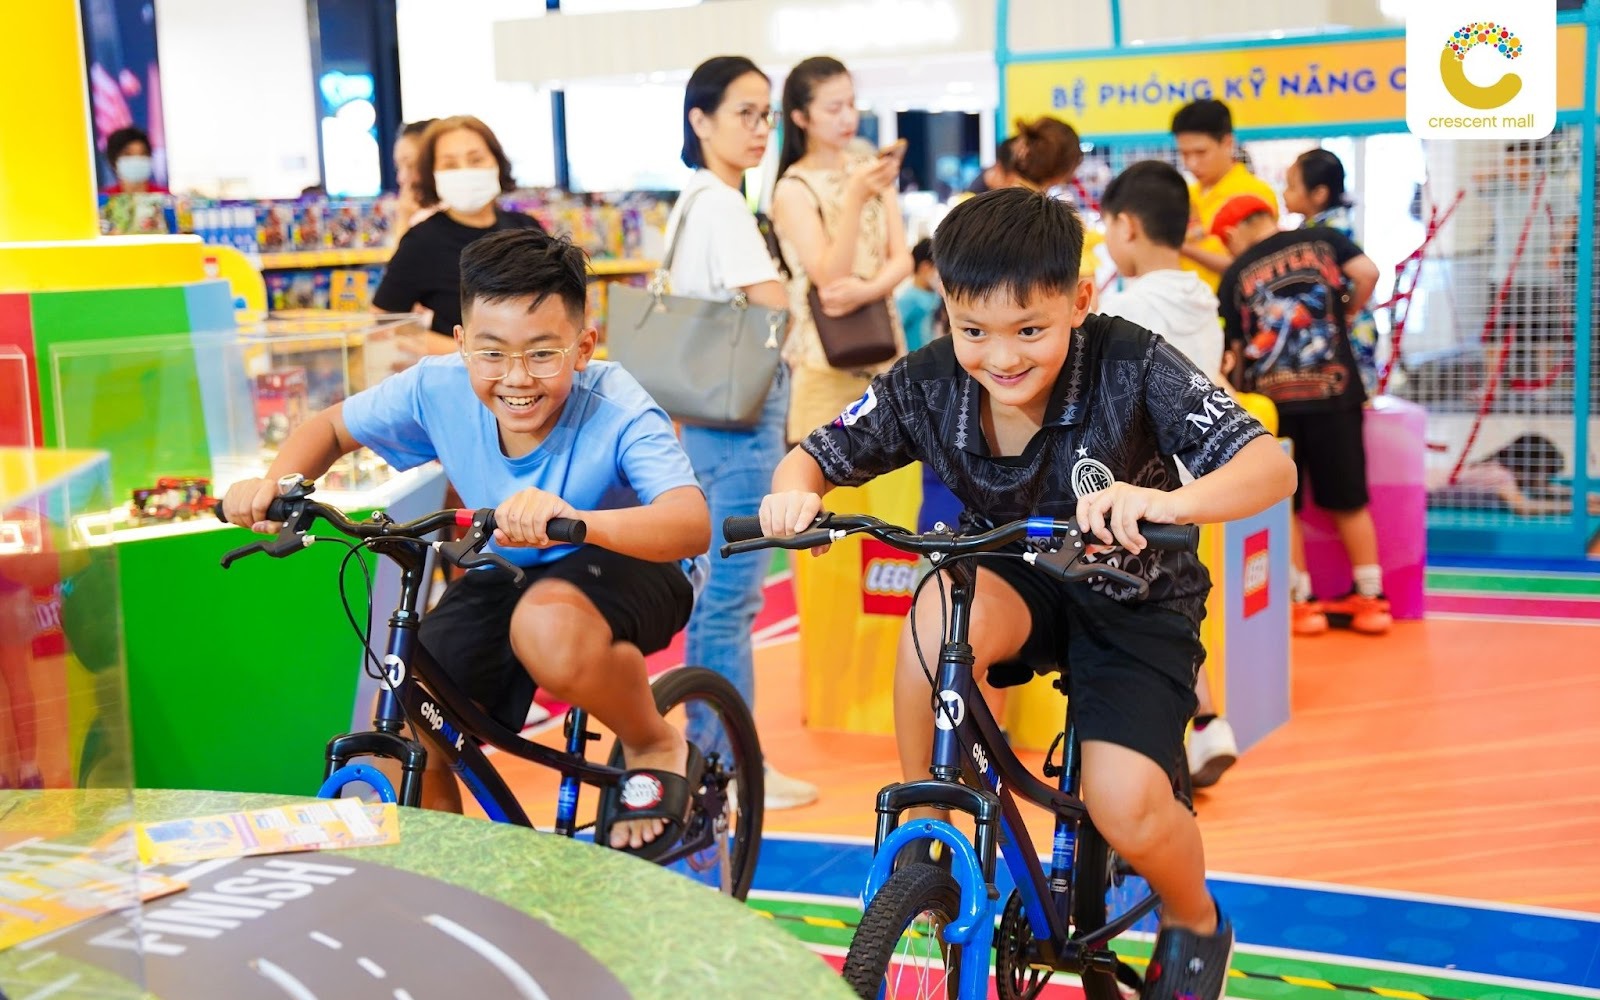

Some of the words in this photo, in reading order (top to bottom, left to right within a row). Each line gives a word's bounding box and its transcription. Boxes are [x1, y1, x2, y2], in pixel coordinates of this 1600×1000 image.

[1099, 72, 1213, 107] PHÓNG
[1225, 68, 1266, 99] KỸ
[87, 859, 356, 956] FINISH
